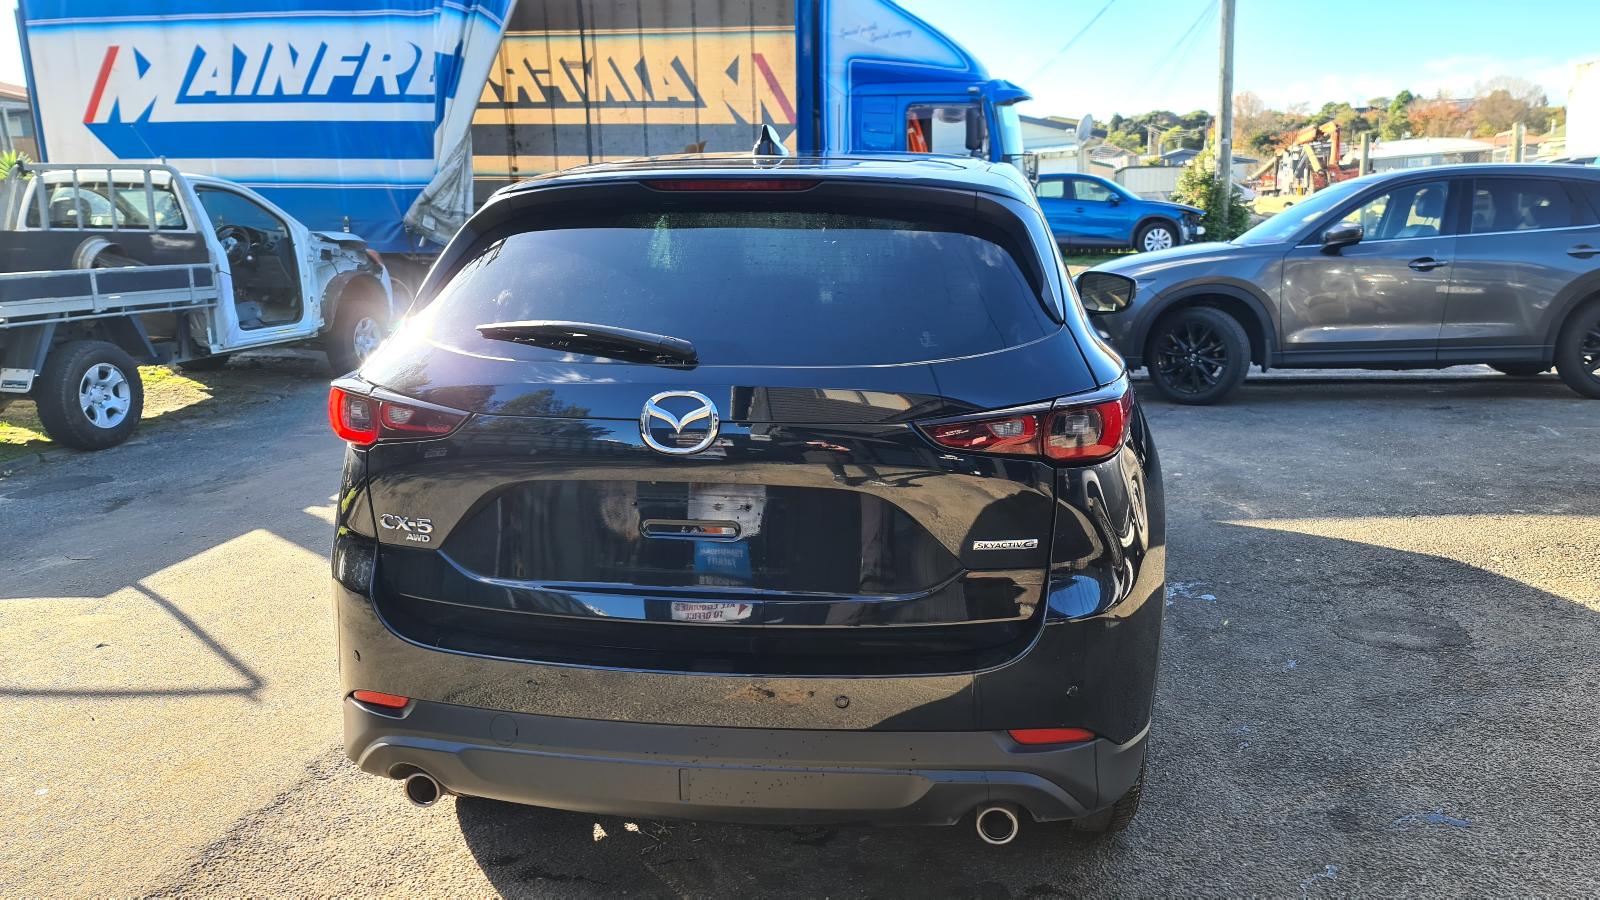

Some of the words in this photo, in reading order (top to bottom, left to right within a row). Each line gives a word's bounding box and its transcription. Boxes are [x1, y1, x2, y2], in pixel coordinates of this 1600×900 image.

[82, 40, 440, 124] MAINFRE
[380, 513, 434, 533] CX-5
[406, 533, 431, 543] AWD
